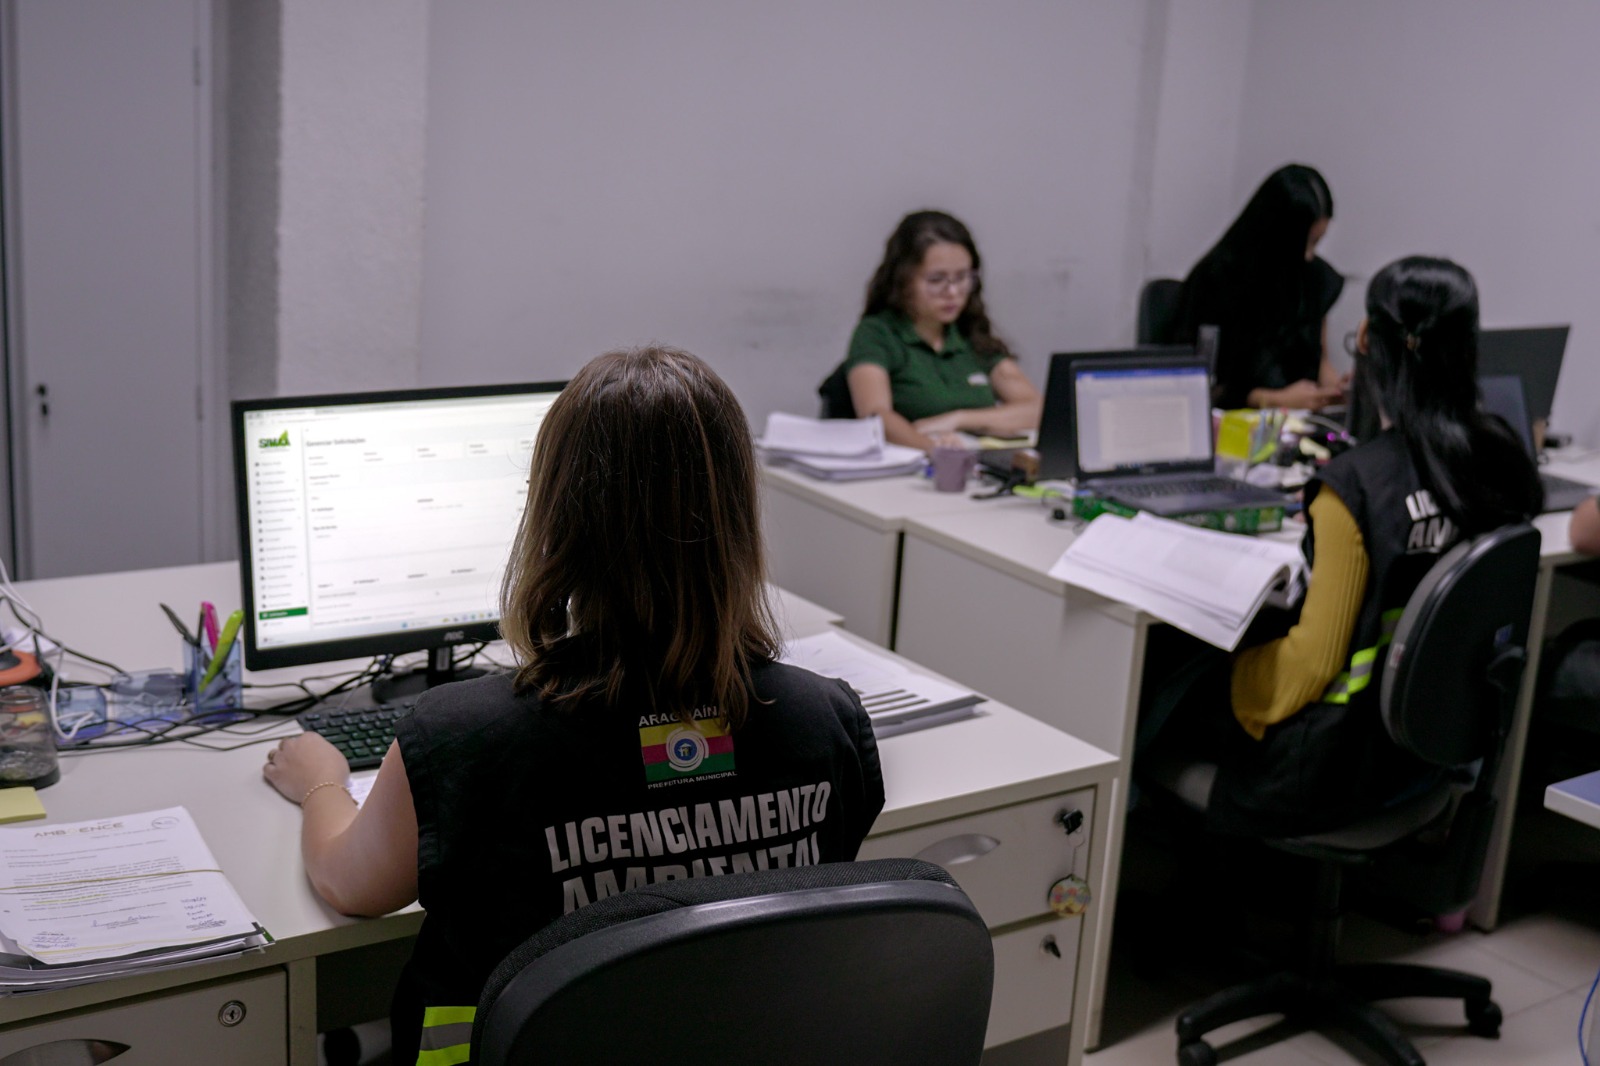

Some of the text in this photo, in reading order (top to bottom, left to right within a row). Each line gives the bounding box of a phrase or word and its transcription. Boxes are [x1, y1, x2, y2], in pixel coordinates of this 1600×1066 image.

[638, 704, 724, 727] ARAGAÍN
[647, 770, 738, 790] PREFEITURA MUNICIPAL
[544, 781, 832, 874] LICENCIAMENTO
